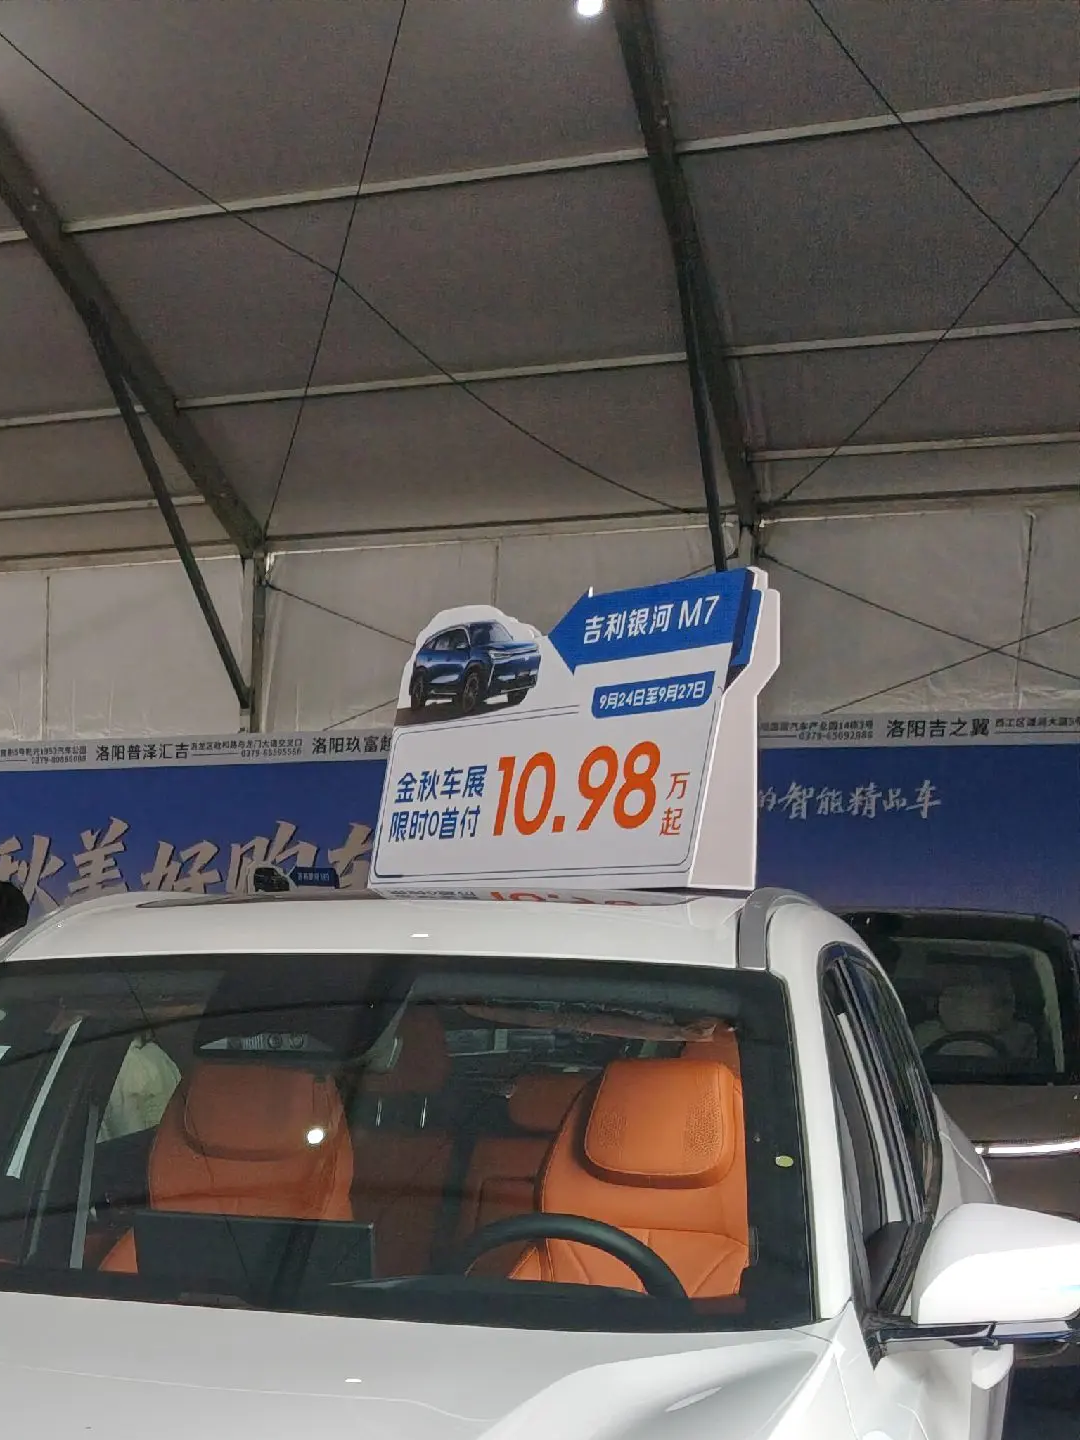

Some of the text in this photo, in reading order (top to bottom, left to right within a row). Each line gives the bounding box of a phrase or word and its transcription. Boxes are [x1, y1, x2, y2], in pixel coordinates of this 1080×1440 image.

[584, 595, 720, 645] 吉利银河 M7
[599, 681, 706, 710] 9月24日至9月27日
[886, 718, 989, 738] 洛阳吉之翼
[95, 743, 189, 762] 洛阳普泽汇吉
[394, 765, 488, 804] 金秋车展
[493, 741, 661, 837] 10.98
[388, 805, 481, 843] 限时0首付
